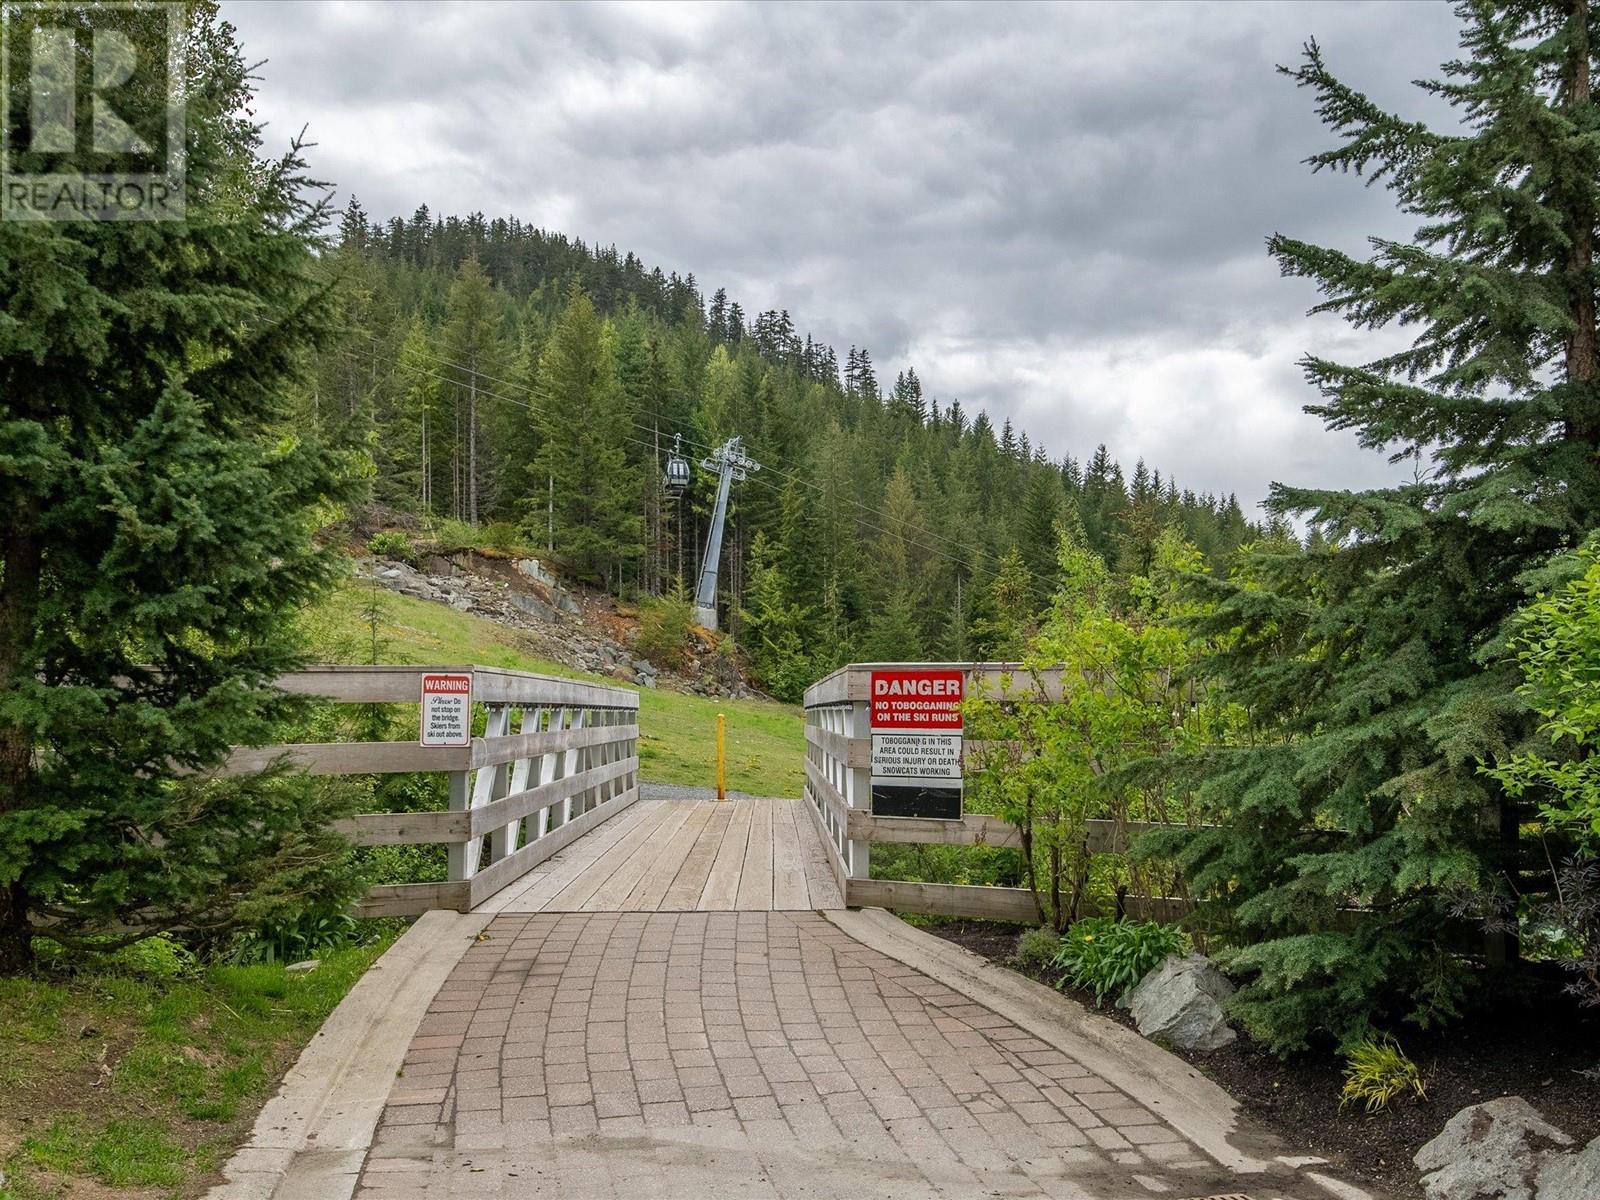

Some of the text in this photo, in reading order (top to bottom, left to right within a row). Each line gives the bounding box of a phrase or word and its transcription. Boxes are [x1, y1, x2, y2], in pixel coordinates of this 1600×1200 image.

[425, 680, 468, 690] WARNING
[875, 680, 960, 695] DANGER
[891, 702, 960, 710] TOBOGGANING
[913, 713, 929, 721] SKI
[932, 713, 958, 721] RUNS
